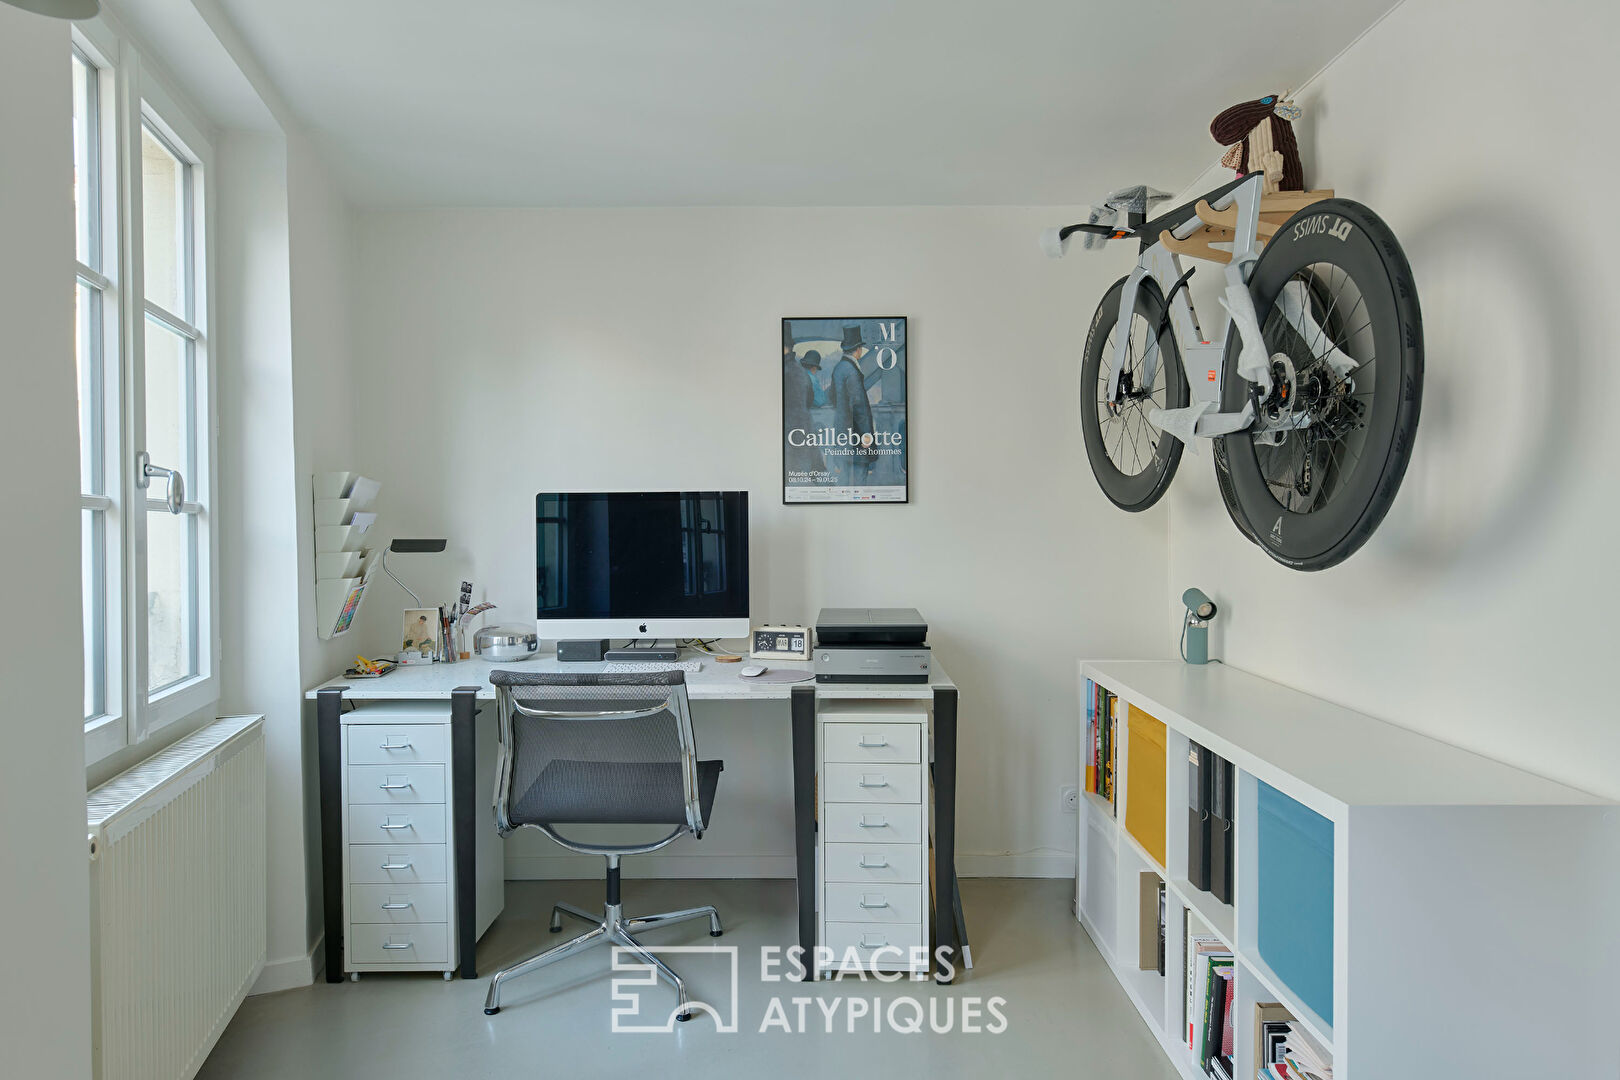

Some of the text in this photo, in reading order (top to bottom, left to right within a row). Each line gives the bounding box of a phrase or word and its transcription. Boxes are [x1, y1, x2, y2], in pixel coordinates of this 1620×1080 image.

[1293, 215, 1353, 241] DT SWISS
[878, 322, 896, 342] M
[788, 428, 902, 446] Caillebotte
[824, 447, 902, 456] Peindre les hommes
[793, 639, 803, 648] 18
